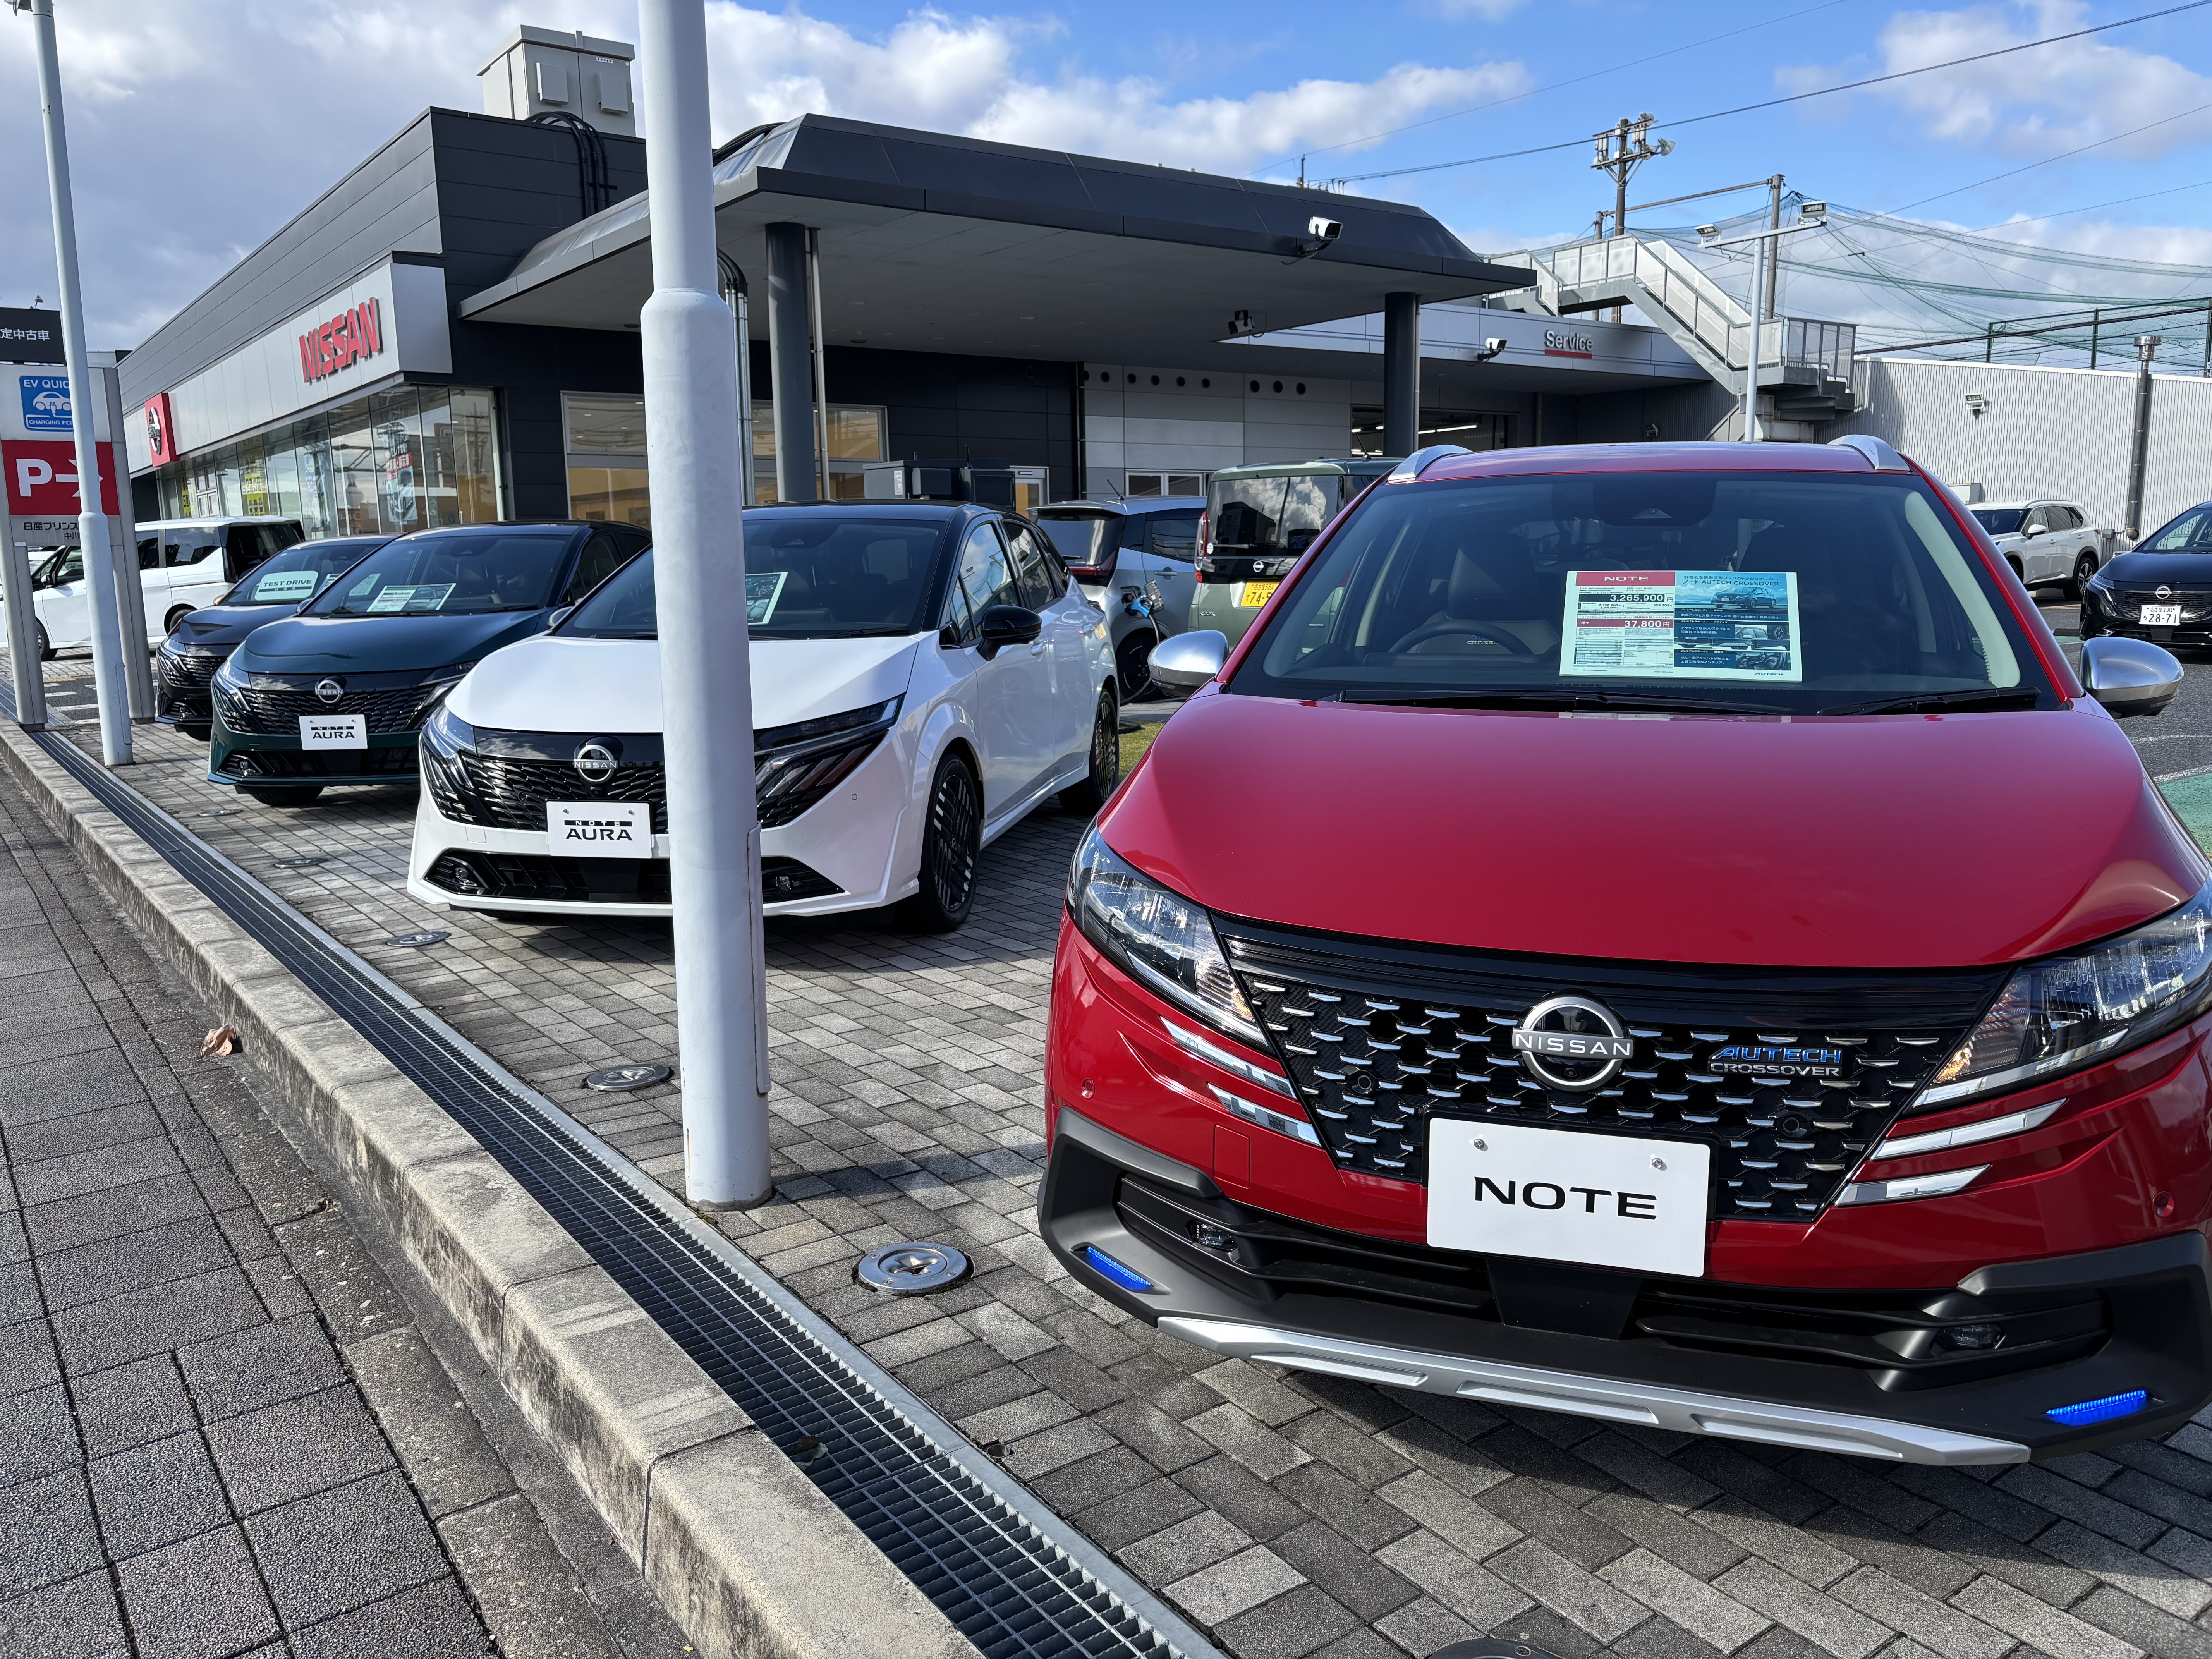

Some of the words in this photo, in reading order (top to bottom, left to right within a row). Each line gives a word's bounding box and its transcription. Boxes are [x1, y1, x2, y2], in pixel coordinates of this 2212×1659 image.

[0, 328, 50, 341] 定中古車
[299, 297, 380, 383] NISSAN
[1546, 330, 1593, 351] Service
[23, 379, 38, 387] EV
[42, 380, 69, 388] QUIC
[16, 459, 52, 497] P
[24, 522, 79, 531] 日産プリンス
[2148, 613, 2176, 623] 28-71
[565, 828, 633, 841] AURA
[1516, 1034, 1630, 1056] NISSAN
[1711, 1047, 1841, 1063] AUTECH
[1710, 1063, 1840, 1077] CROSSOVER
[1474, 1176, 1657, 1220] NOTE
